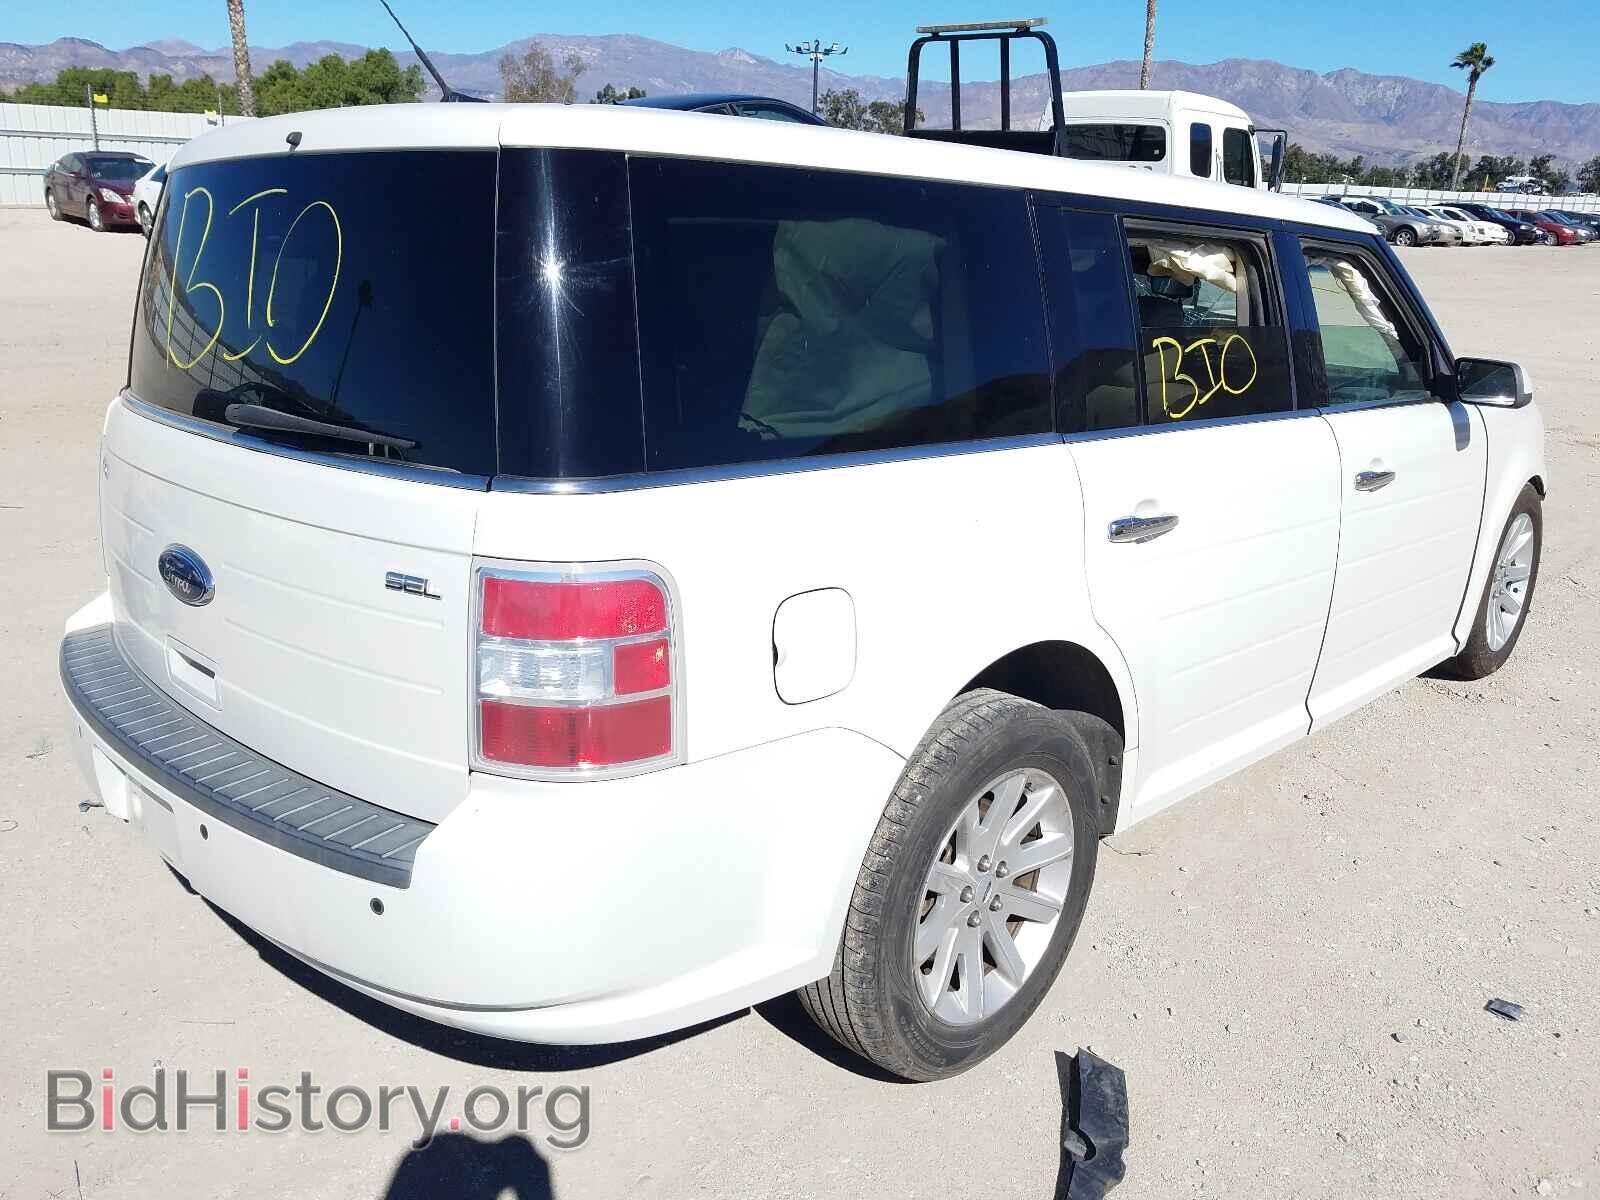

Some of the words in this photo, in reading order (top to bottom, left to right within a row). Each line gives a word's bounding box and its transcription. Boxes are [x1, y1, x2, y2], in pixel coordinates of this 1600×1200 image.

[166, 187, 342, 369] BIO
[1152, 334, 1257, 418] BIO
[385, 571, 441, 600] SEL
